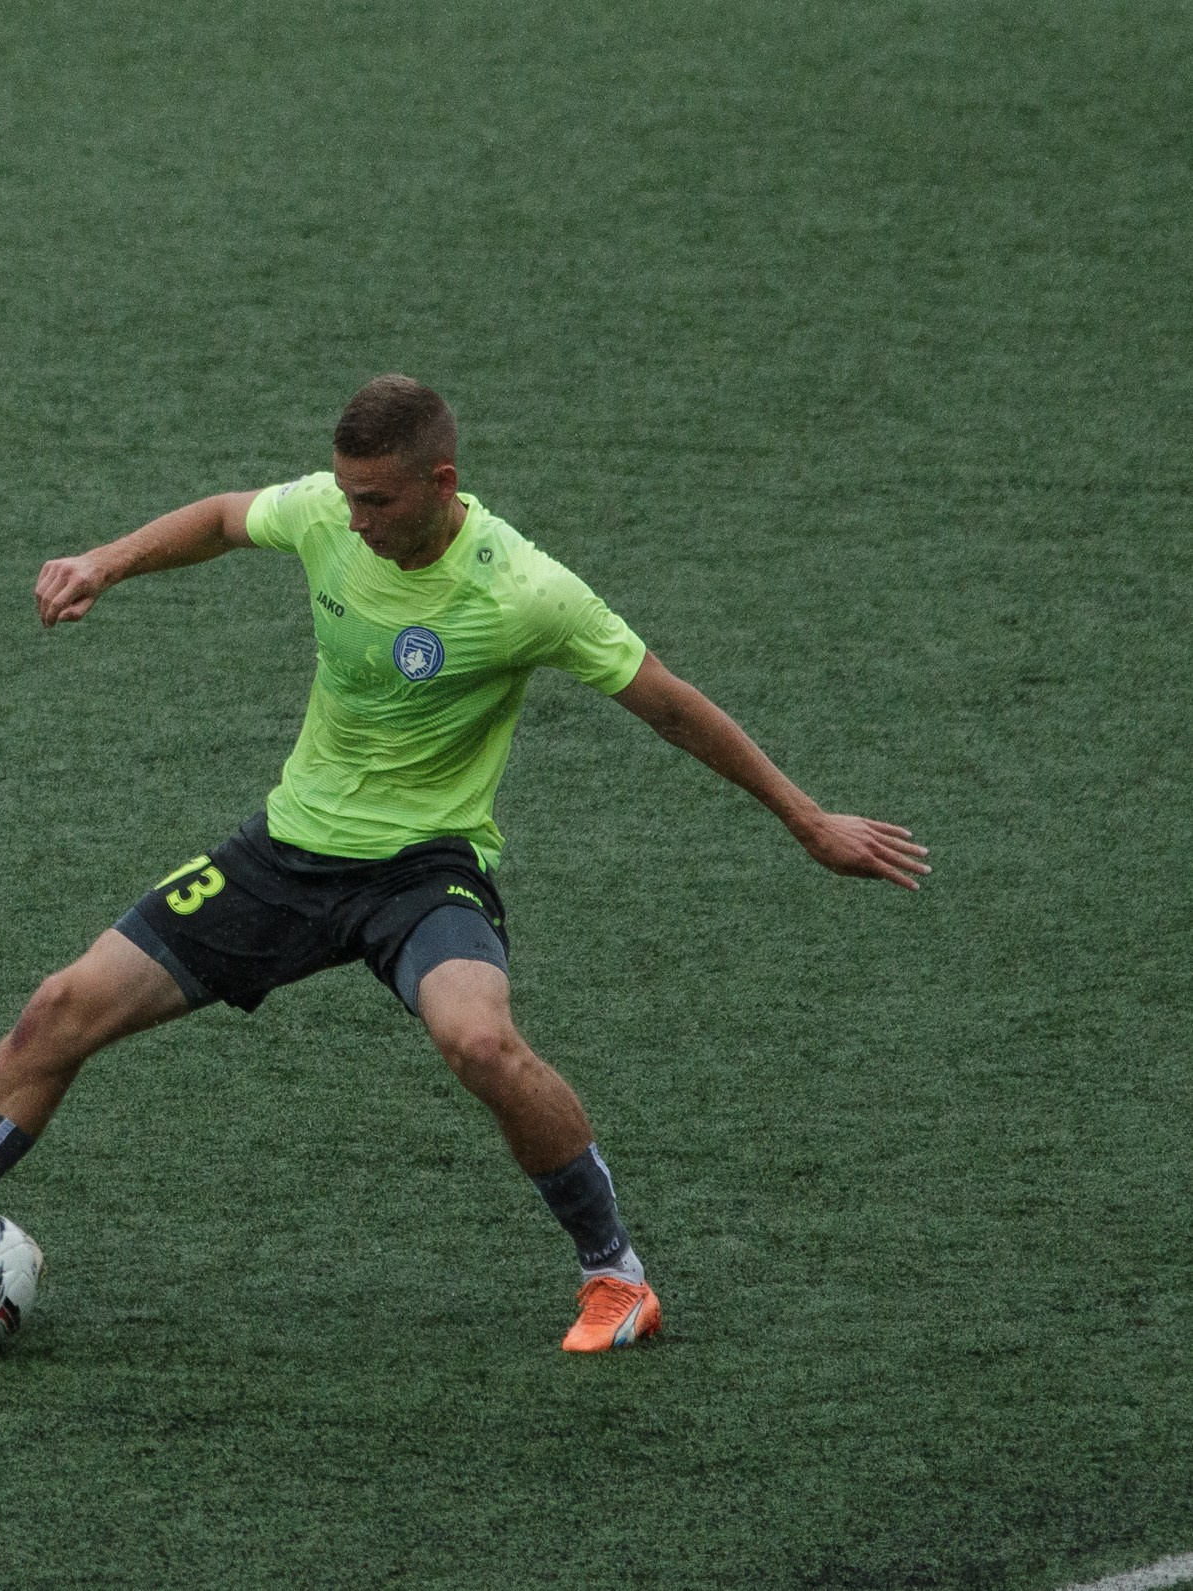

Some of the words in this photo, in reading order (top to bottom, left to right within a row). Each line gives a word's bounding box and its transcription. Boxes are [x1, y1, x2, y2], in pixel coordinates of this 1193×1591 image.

[316, 591, 344, 617] JAKO
[154, 855, 225, 915] 13
[447, 885, 483, 907] JAKO
